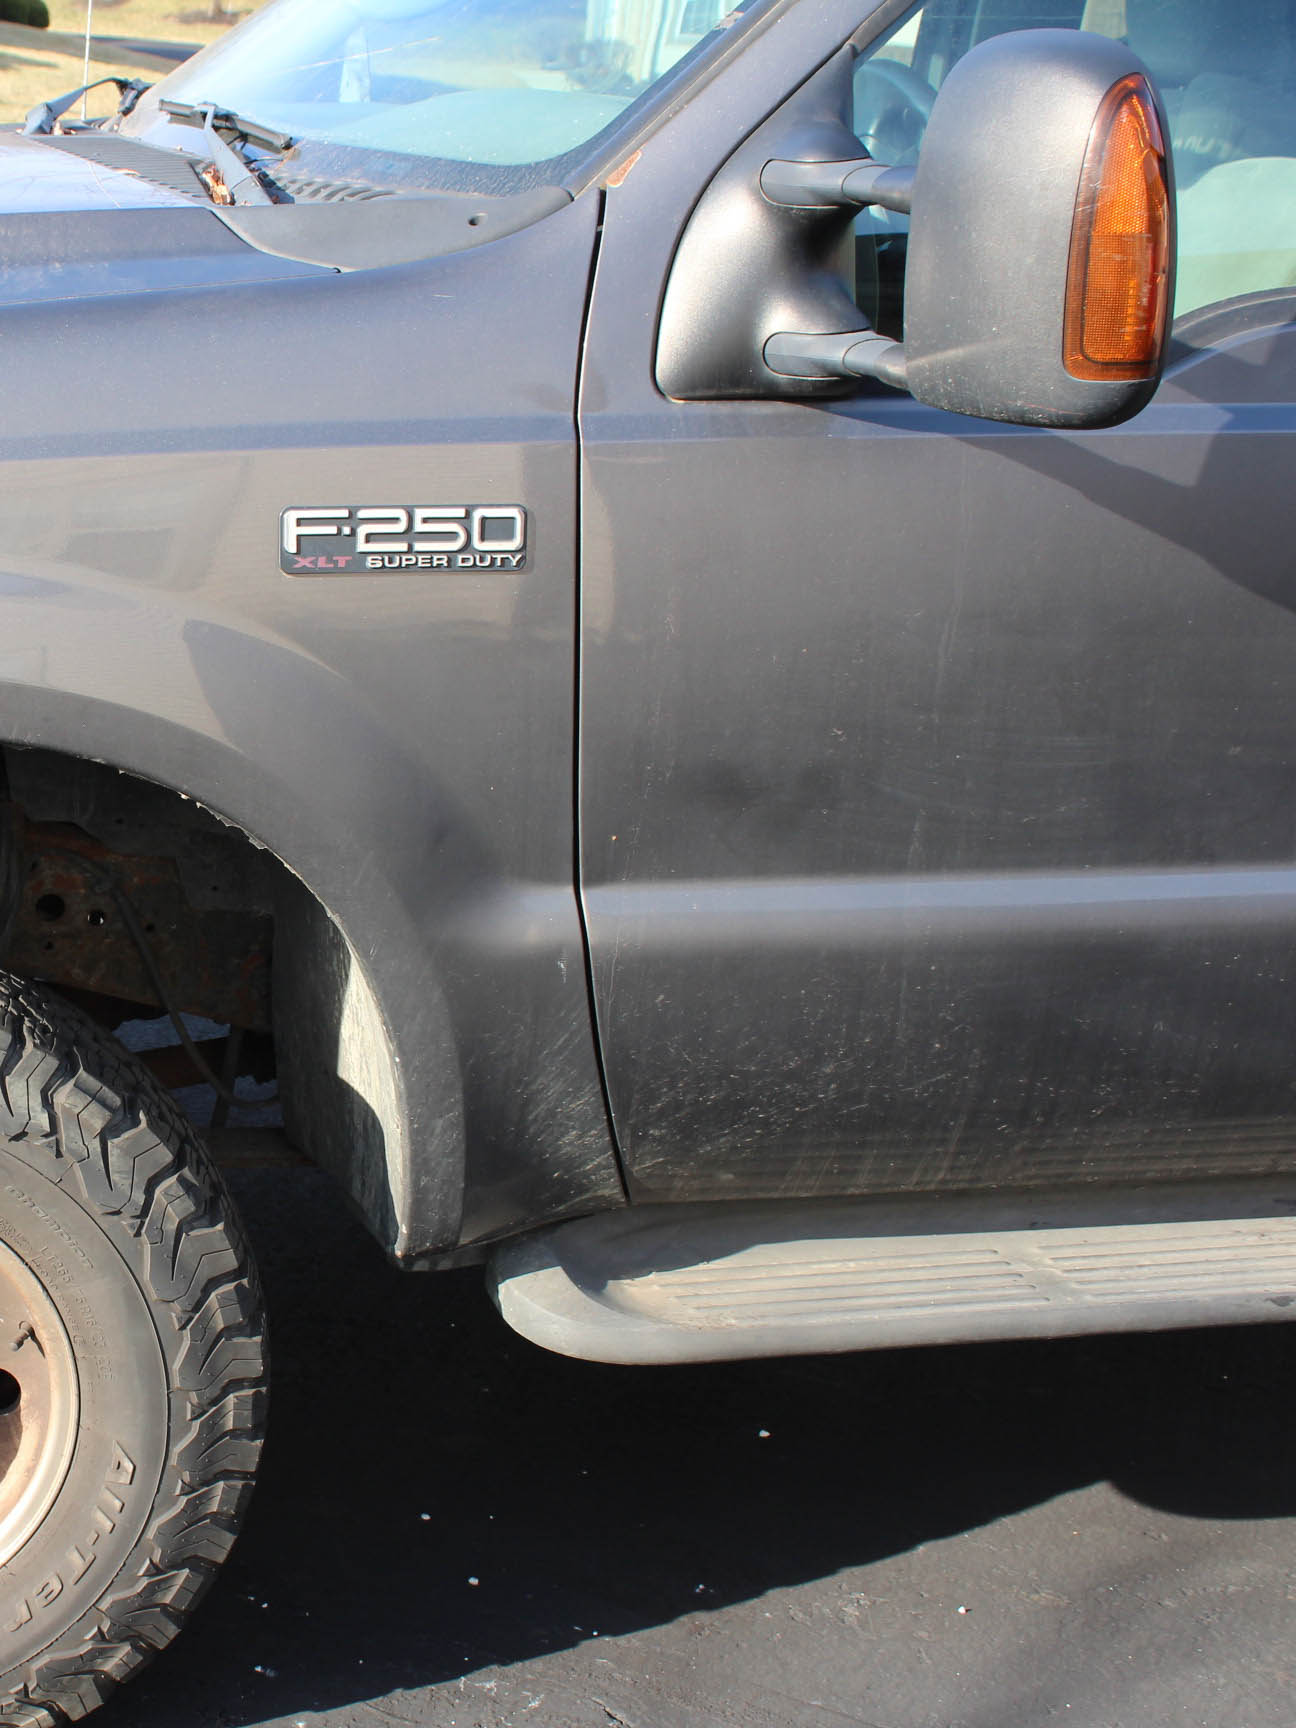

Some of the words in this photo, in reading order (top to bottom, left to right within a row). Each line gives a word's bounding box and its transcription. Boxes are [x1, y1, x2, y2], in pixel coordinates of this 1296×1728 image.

[292, 556, 353, 569] XLT
[366, 554, 449, 570] SUPER
[457, 553, 522, 568] DUTY
